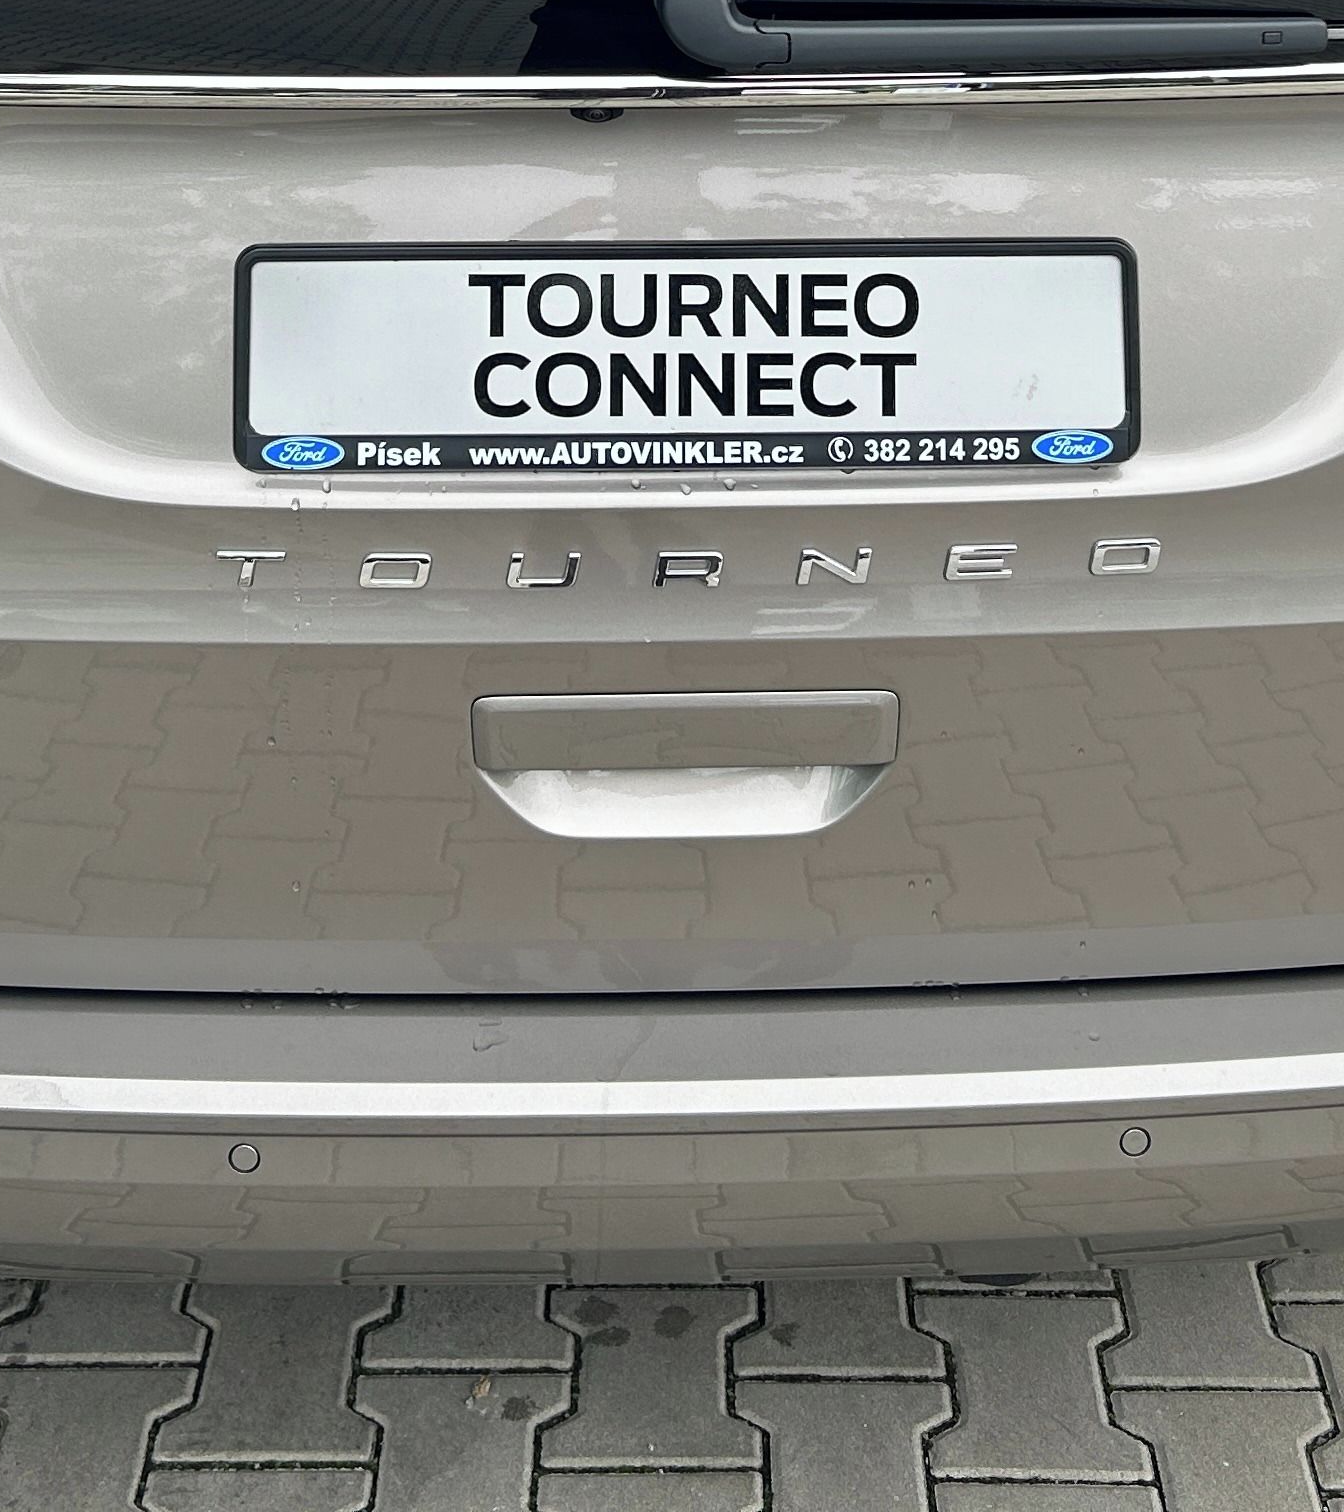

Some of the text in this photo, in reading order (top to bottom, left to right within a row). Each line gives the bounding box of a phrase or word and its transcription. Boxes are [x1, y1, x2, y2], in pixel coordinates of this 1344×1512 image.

[467, 273, 919, 338] TOURNEO
[473, 352, 918, 418] CONNECT
[279, 435, 1096, 466] Ford Písek www.AUTOVINKLER.cz 382 214 295 Ford
[214, 536, 1162, 591] TOURNEO
